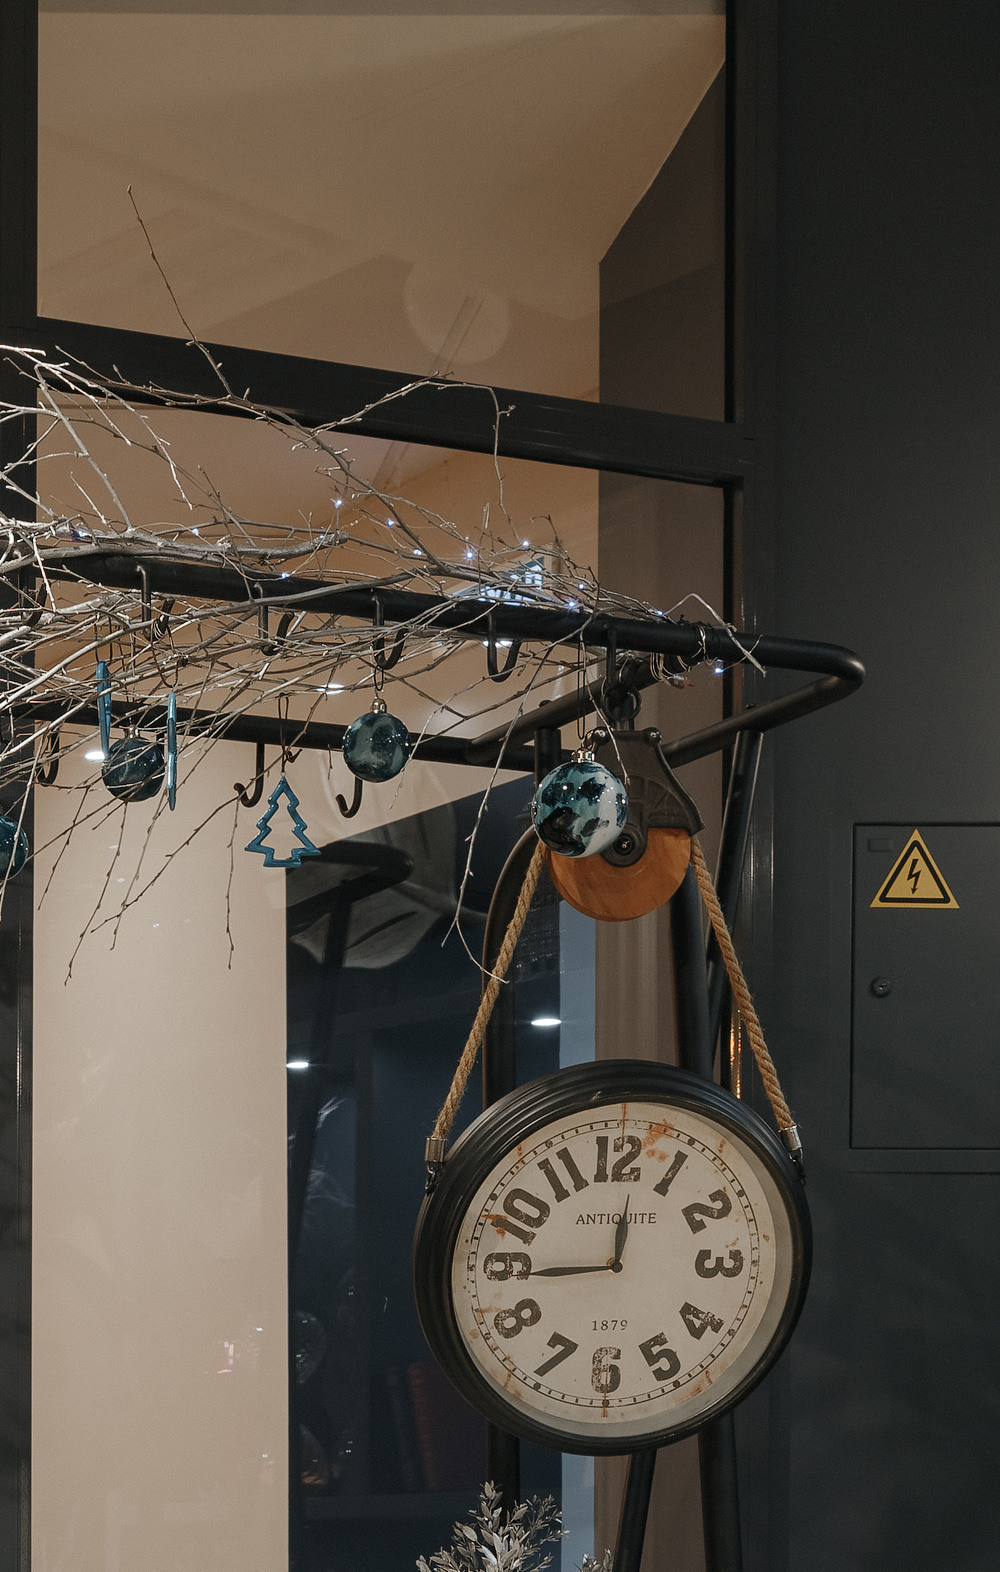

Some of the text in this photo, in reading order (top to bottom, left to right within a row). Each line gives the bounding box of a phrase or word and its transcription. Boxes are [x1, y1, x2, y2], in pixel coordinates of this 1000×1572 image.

[537, 1147, 589, 1203] 11
[594, 1135, 641, 1182] 12
[653, 1150, 688, 1197] 1
[490, 1188, 550, 1246] 10
[575, 1213, 657, 1225] ANTIQUITE
[681, 1189, 732, 1234] 2
[483, 1251, 532, 1281] 9
[694, 1249, 744, 1279] 3
[493, 1298, 542, 1339] 8
[592, 1319, 628, 1331] 1879
[679, 1301, 724, 1340] 4
[533, 1331, 579, 1377] 7
[591, 1346, 622, 1394] 6
[638, 1332, 681, 1381] 5
